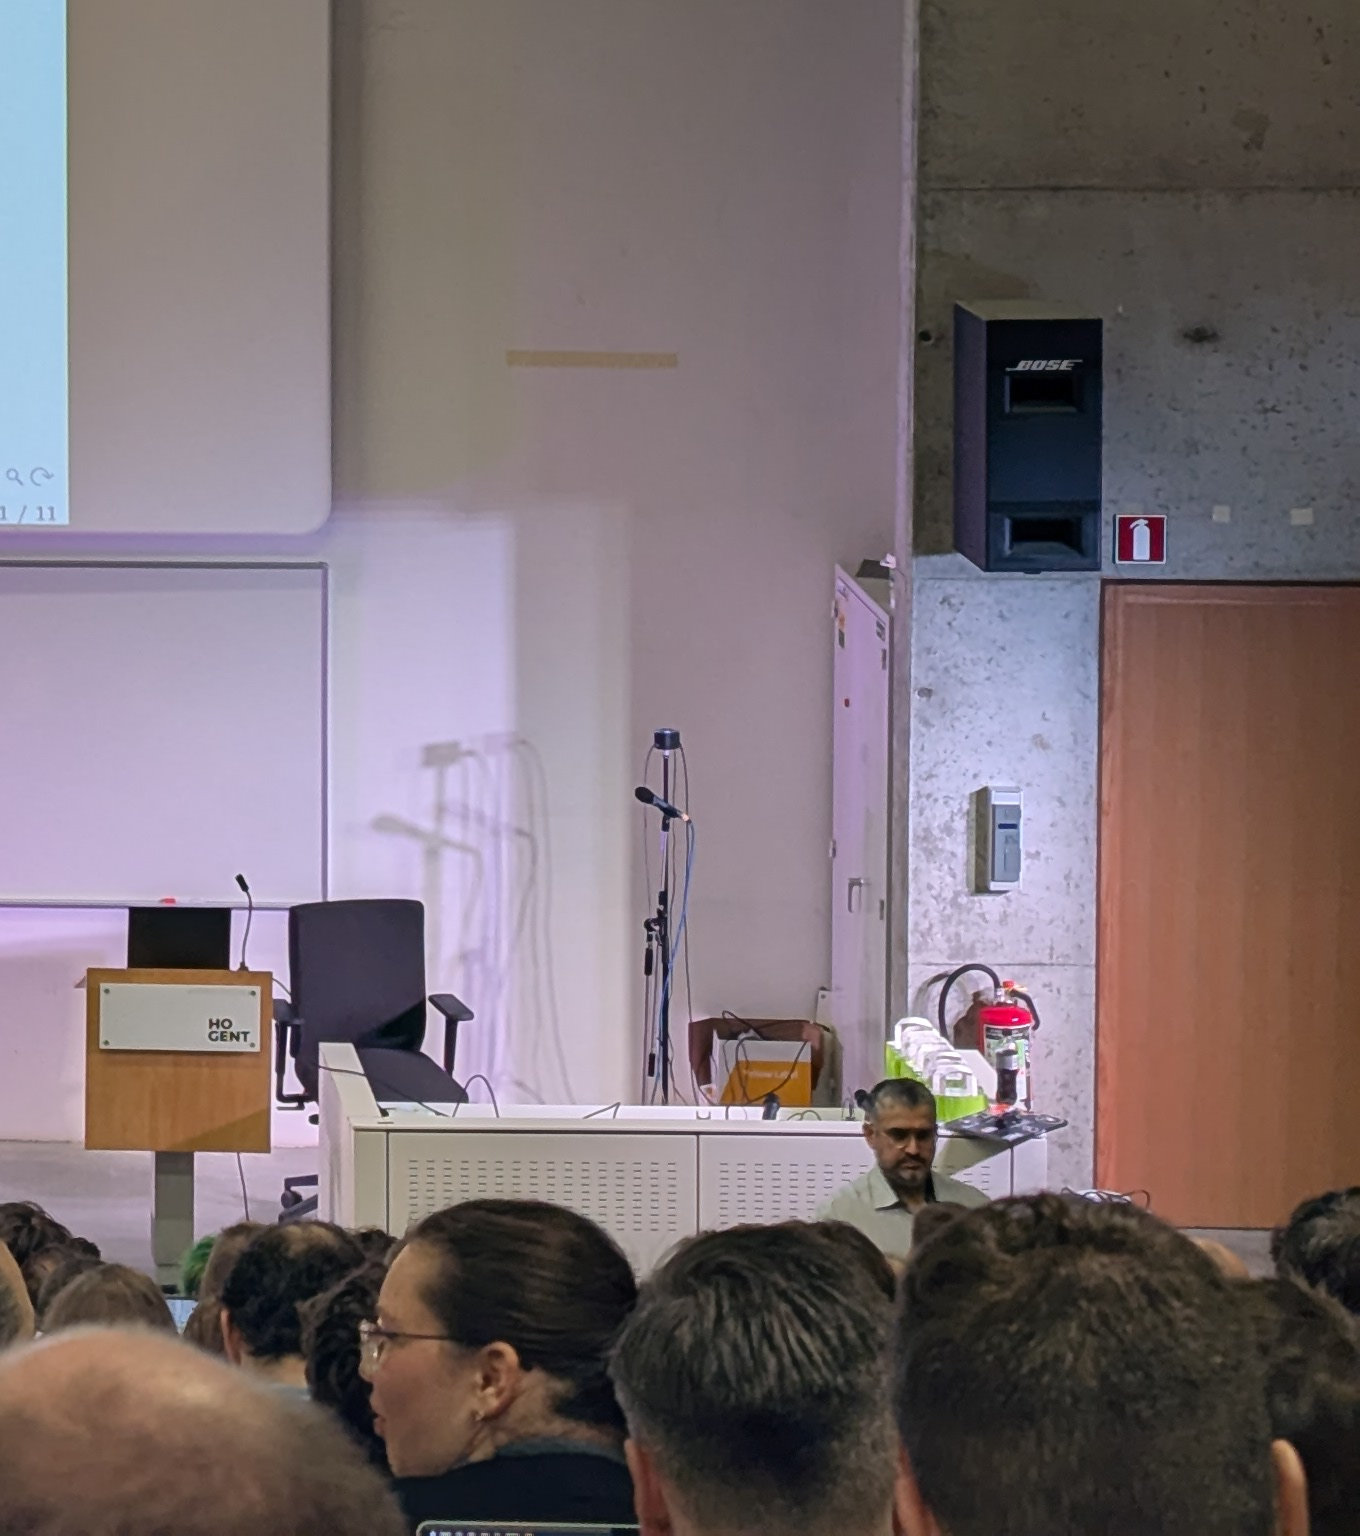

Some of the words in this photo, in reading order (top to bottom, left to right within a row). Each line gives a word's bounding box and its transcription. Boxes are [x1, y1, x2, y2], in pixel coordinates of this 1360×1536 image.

[1005, 359, 1083, 371] BOSE
[17, 505, 28, 524] /
[36, 505, 56, 521] 11
[208, 1017, 233, 1030] HO
[207, 1030, 251, 1043] GENT
